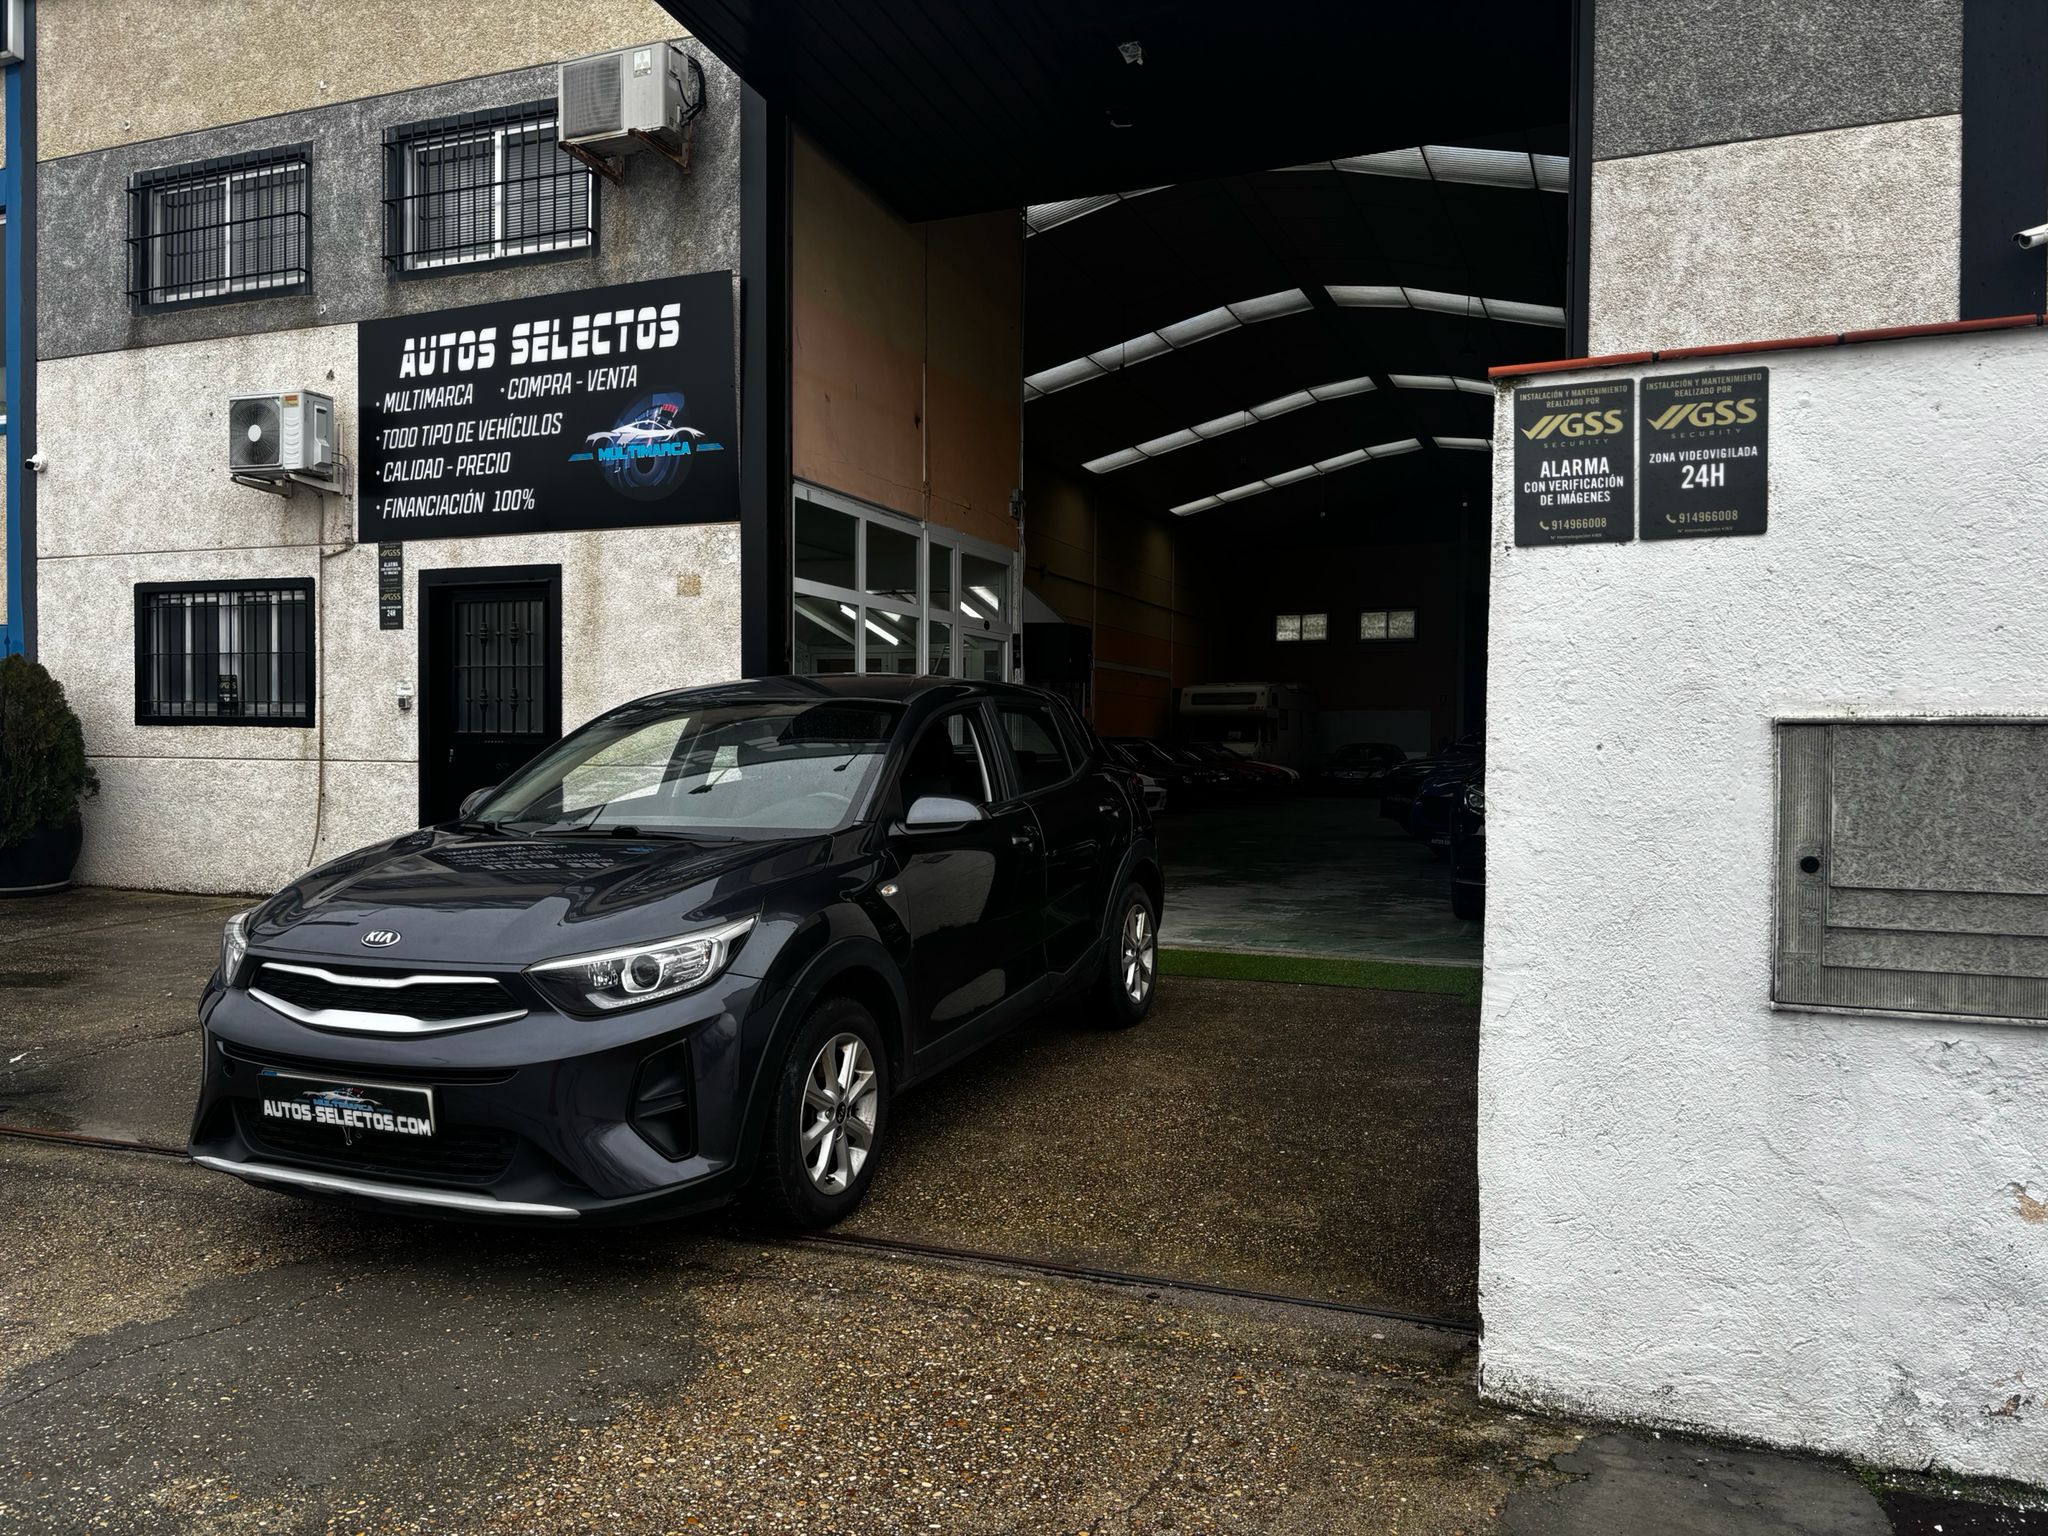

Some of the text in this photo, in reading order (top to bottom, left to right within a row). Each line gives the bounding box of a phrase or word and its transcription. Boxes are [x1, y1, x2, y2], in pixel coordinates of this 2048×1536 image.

[399, 303, 681, 378] AUTOS SELECTOS
[507, 372, 572, 400] COMPRA
[586, 364, 638, 392] VENTA
[1646, 373, 1762, 391] INSTALACIÓN Y MANTENIMIENTO
[1674, 385, 1732, 398] REALIZADO POR
[383, 383, 474, 414] MULTIMARCA
[1519, 385, 1628, 401] INSTALACIÓN Y MANTENIMIENTO
[1546, 397, 1600, 408] REALIZADO POR
[1688, 398, 1758, 427] GSS
[382, 412, 563, 451] TODO TIPO DE VEHÍCULOS
[1559, 409, 1624, 438] GSS
[1671, 427, 1742, 439] SECURITY
[597, 441, 692, 462] MULTIMARCA
[1543, 438, 1609, 449] SECURITY
[1649, 446, 1758, 464] ZONA VIDEOVIGILADA
[383, 459, 443, 483] CALIDAD
[456, 452, 511, 477] PRECIO
[1540, 457, 1610, 478] ALARMA
[1681, 462, 1725, 489] 24H
[1524, 474, 1624, 493] CON VERIFICACIÓN
[383, 488, 535, 519] FINANCIACIÓN 100%
[1540, 490, 1611, 506] DE IMÁGENES
[1551, 517, 1607, 531] 914966008
[1678, 510, 1738, 524] 914966008
[365, 931, 393, 943] KIA
[263, 1099, 432, 1137] AUTOS-SELECTOS.COM
